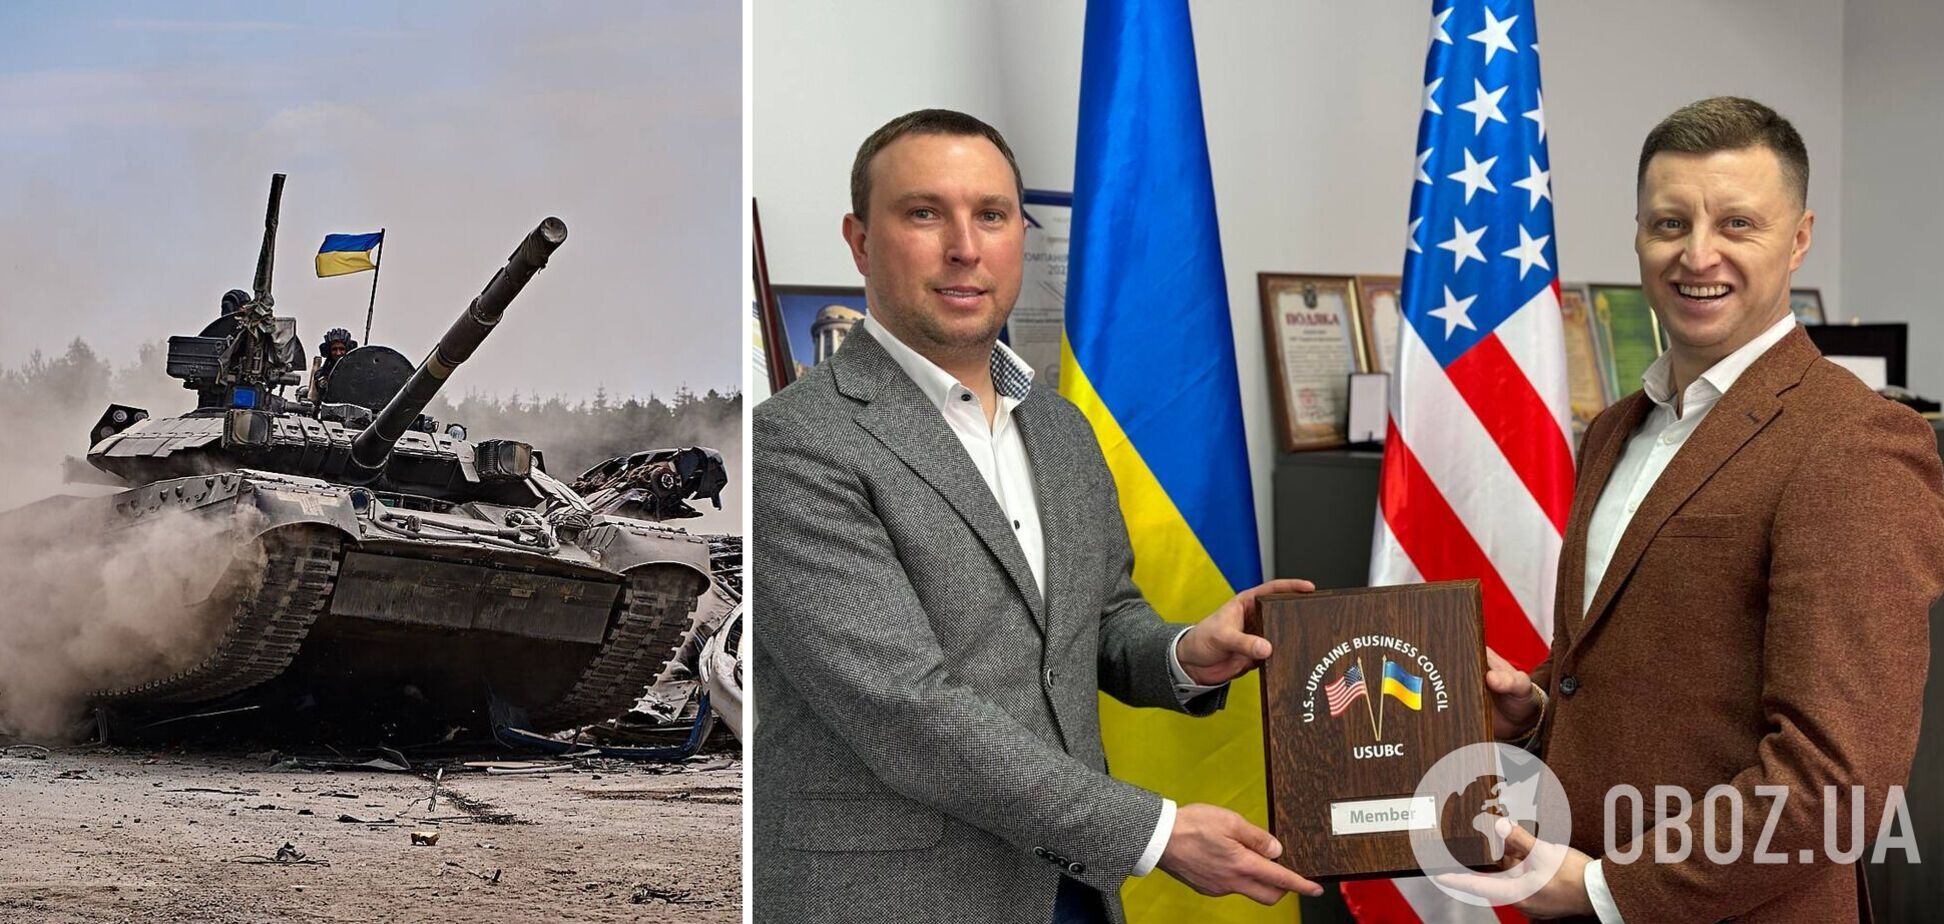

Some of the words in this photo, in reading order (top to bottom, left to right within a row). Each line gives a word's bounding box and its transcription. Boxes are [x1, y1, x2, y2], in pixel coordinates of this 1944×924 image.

[1286, 313, 1340, 326] ПОДЯКА
[1303, 642, 1351, 722] U.S.-UKRAINE
[1352, 635, 1418, 658] BUSINESS
[1417, 655, 1448, 712] COUNCIL
[1353, 743, 1404, 759] USUBC
[1350, 807, 1416, 824] Member
